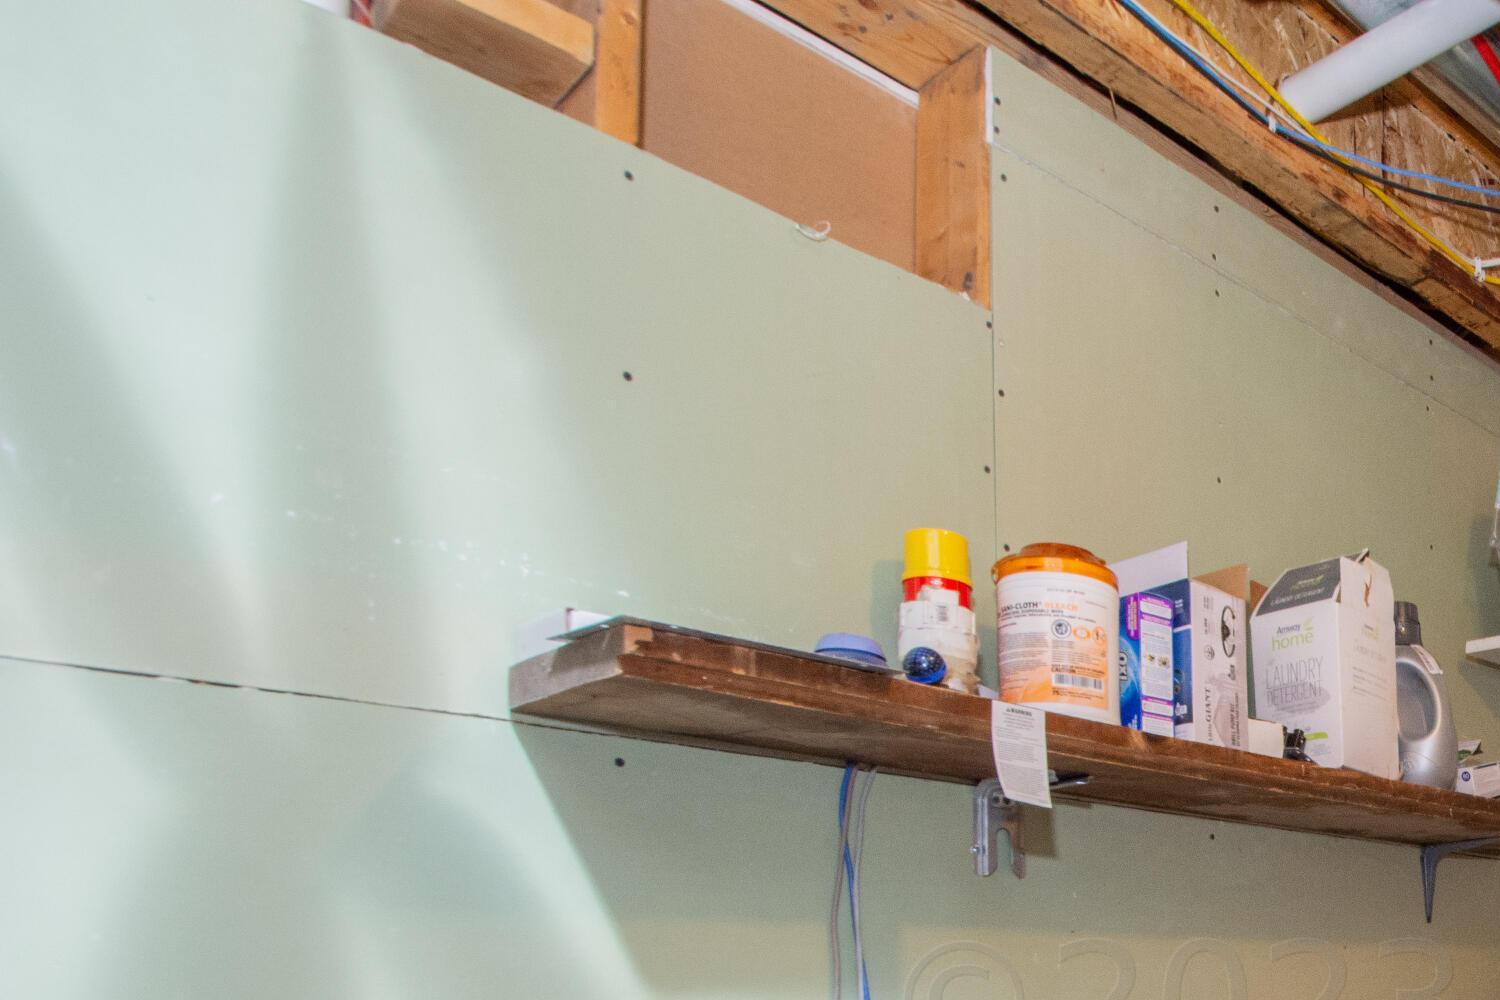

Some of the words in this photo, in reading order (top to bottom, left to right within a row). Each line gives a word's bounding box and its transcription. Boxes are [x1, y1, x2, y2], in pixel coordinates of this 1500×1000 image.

[1271, 631, 1314, 651] home
[1276, 623, 1302, 635] Amway
[1265, 655, 1324, 690] LAUNDRY
[1266, 679, 1323, 707] DETERGENT
